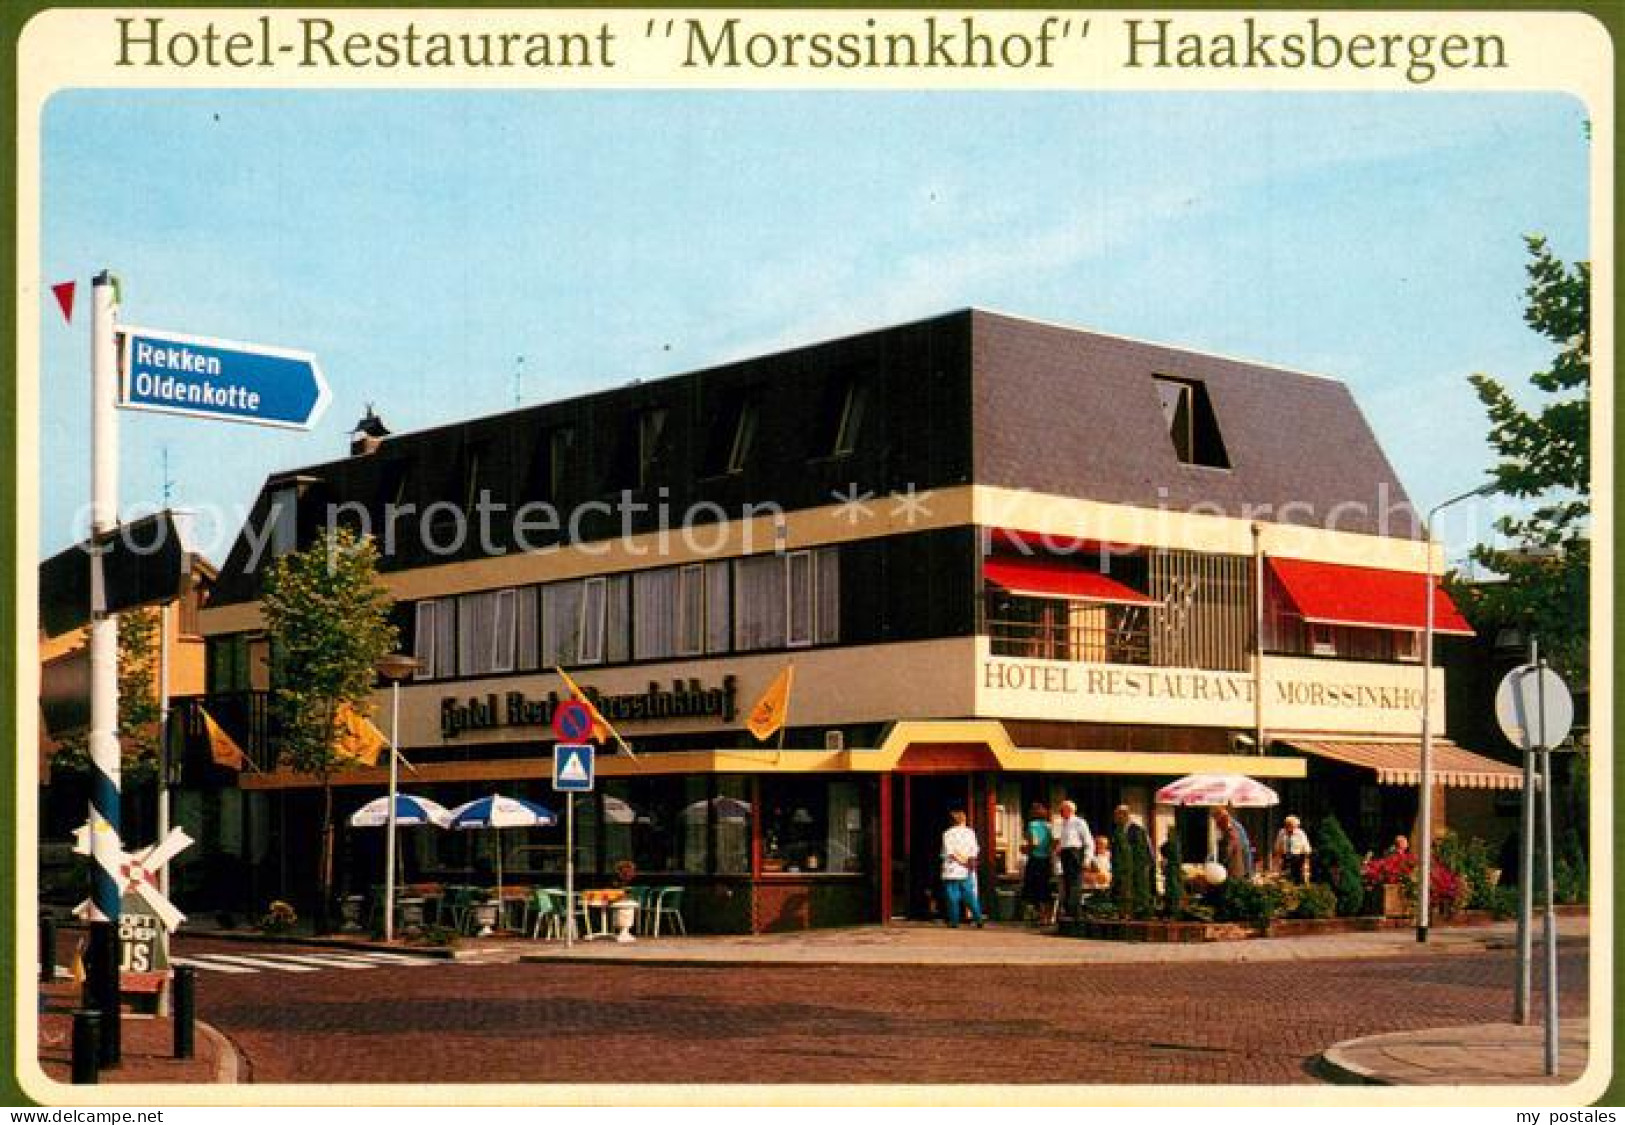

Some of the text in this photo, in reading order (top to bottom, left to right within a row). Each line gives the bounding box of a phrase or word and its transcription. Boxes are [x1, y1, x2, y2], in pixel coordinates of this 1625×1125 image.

[136, 342, 221, 376] Rekken
[136, 372, 261, 410] Oldenkotte
[983, 663, 1077, 694] HOTEL
[1087, 669, 1257, 703] RESTAURANT
